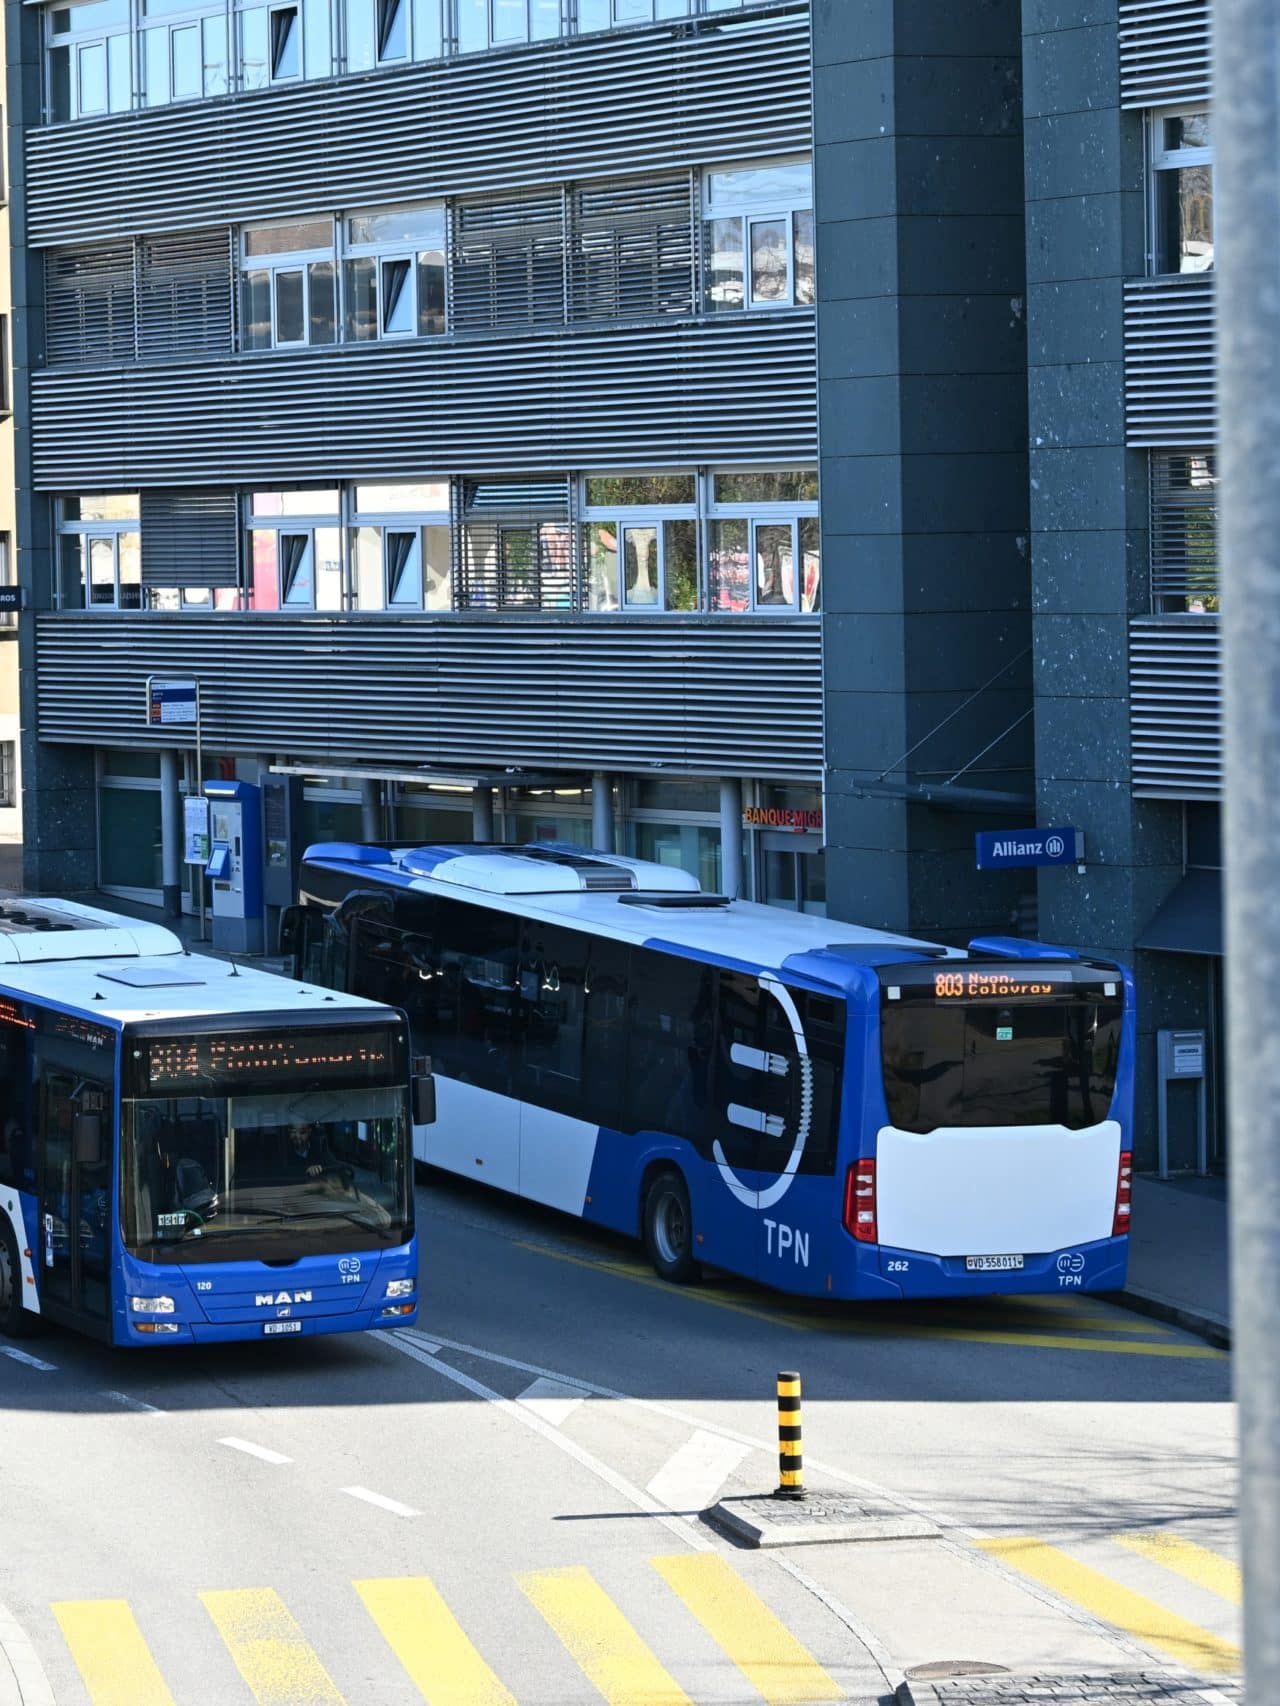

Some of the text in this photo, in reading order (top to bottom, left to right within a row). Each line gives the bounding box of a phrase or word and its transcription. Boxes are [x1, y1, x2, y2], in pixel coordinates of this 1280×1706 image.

[744, 807, 792, 826] BANQUE
[992, 841, 1043, 857] Allianz
[935, 973, 1014, 996] 803 Nyon,
[968, 983, 1052, 995] Colovray
[762, 1218, 810, 1268] TPN
[887, 1261, 910, 1272] 262
[341, 1274, 361, 1284] TPN
[1058, 1275, 1082, 1286] TPN
[197, 1282, 213, 1291] 120
[255, 1291, 313, 1306] MAN
